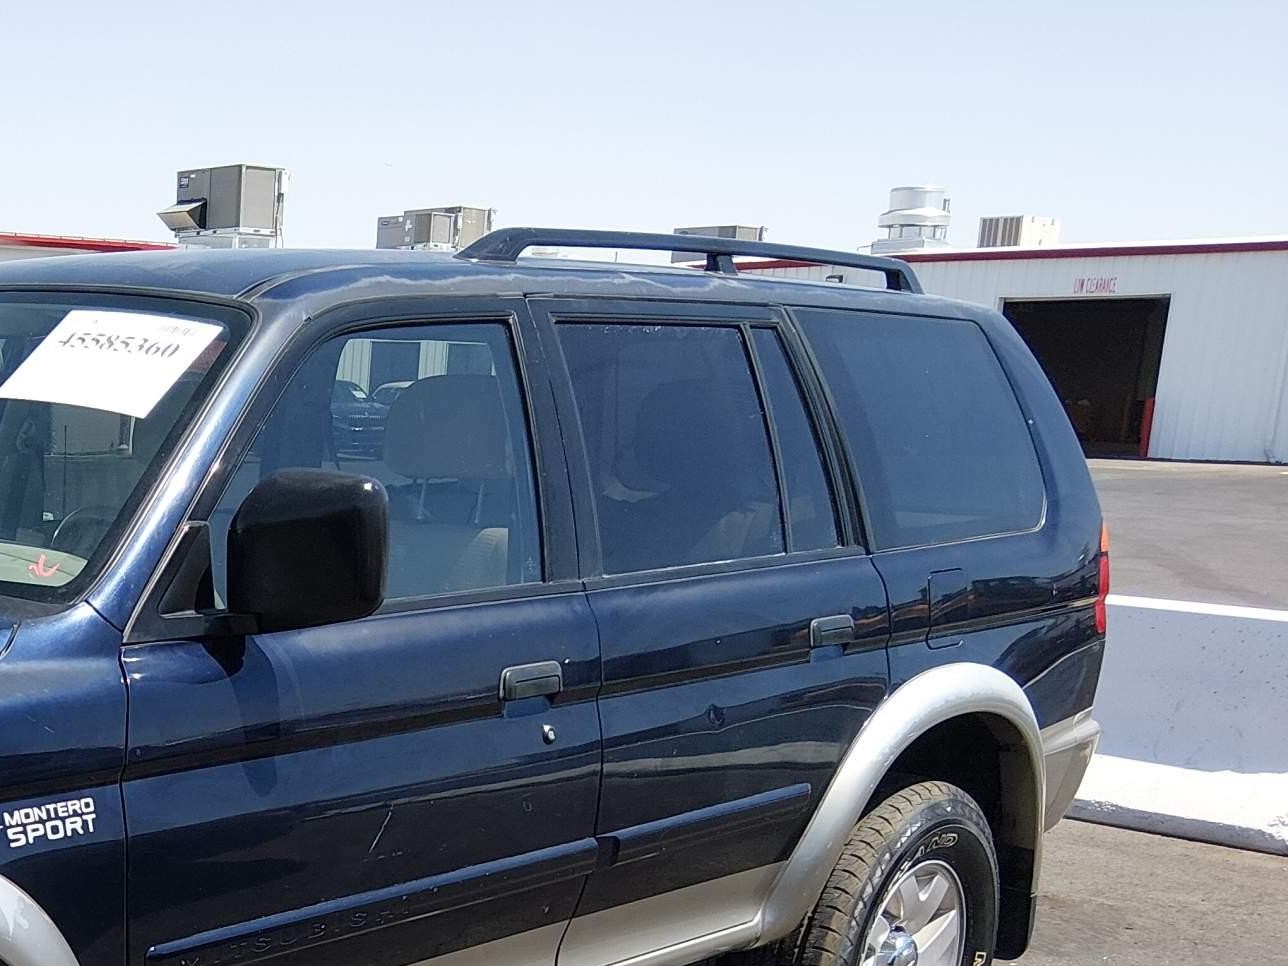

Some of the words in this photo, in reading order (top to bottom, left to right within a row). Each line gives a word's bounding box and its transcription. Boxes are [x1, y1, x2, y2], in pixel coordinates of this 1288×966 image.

[58, 331, 181, 359] 45585360
[3, 797, 95, 827] MONTERO
[6, 813, 97, 848] SPORT
